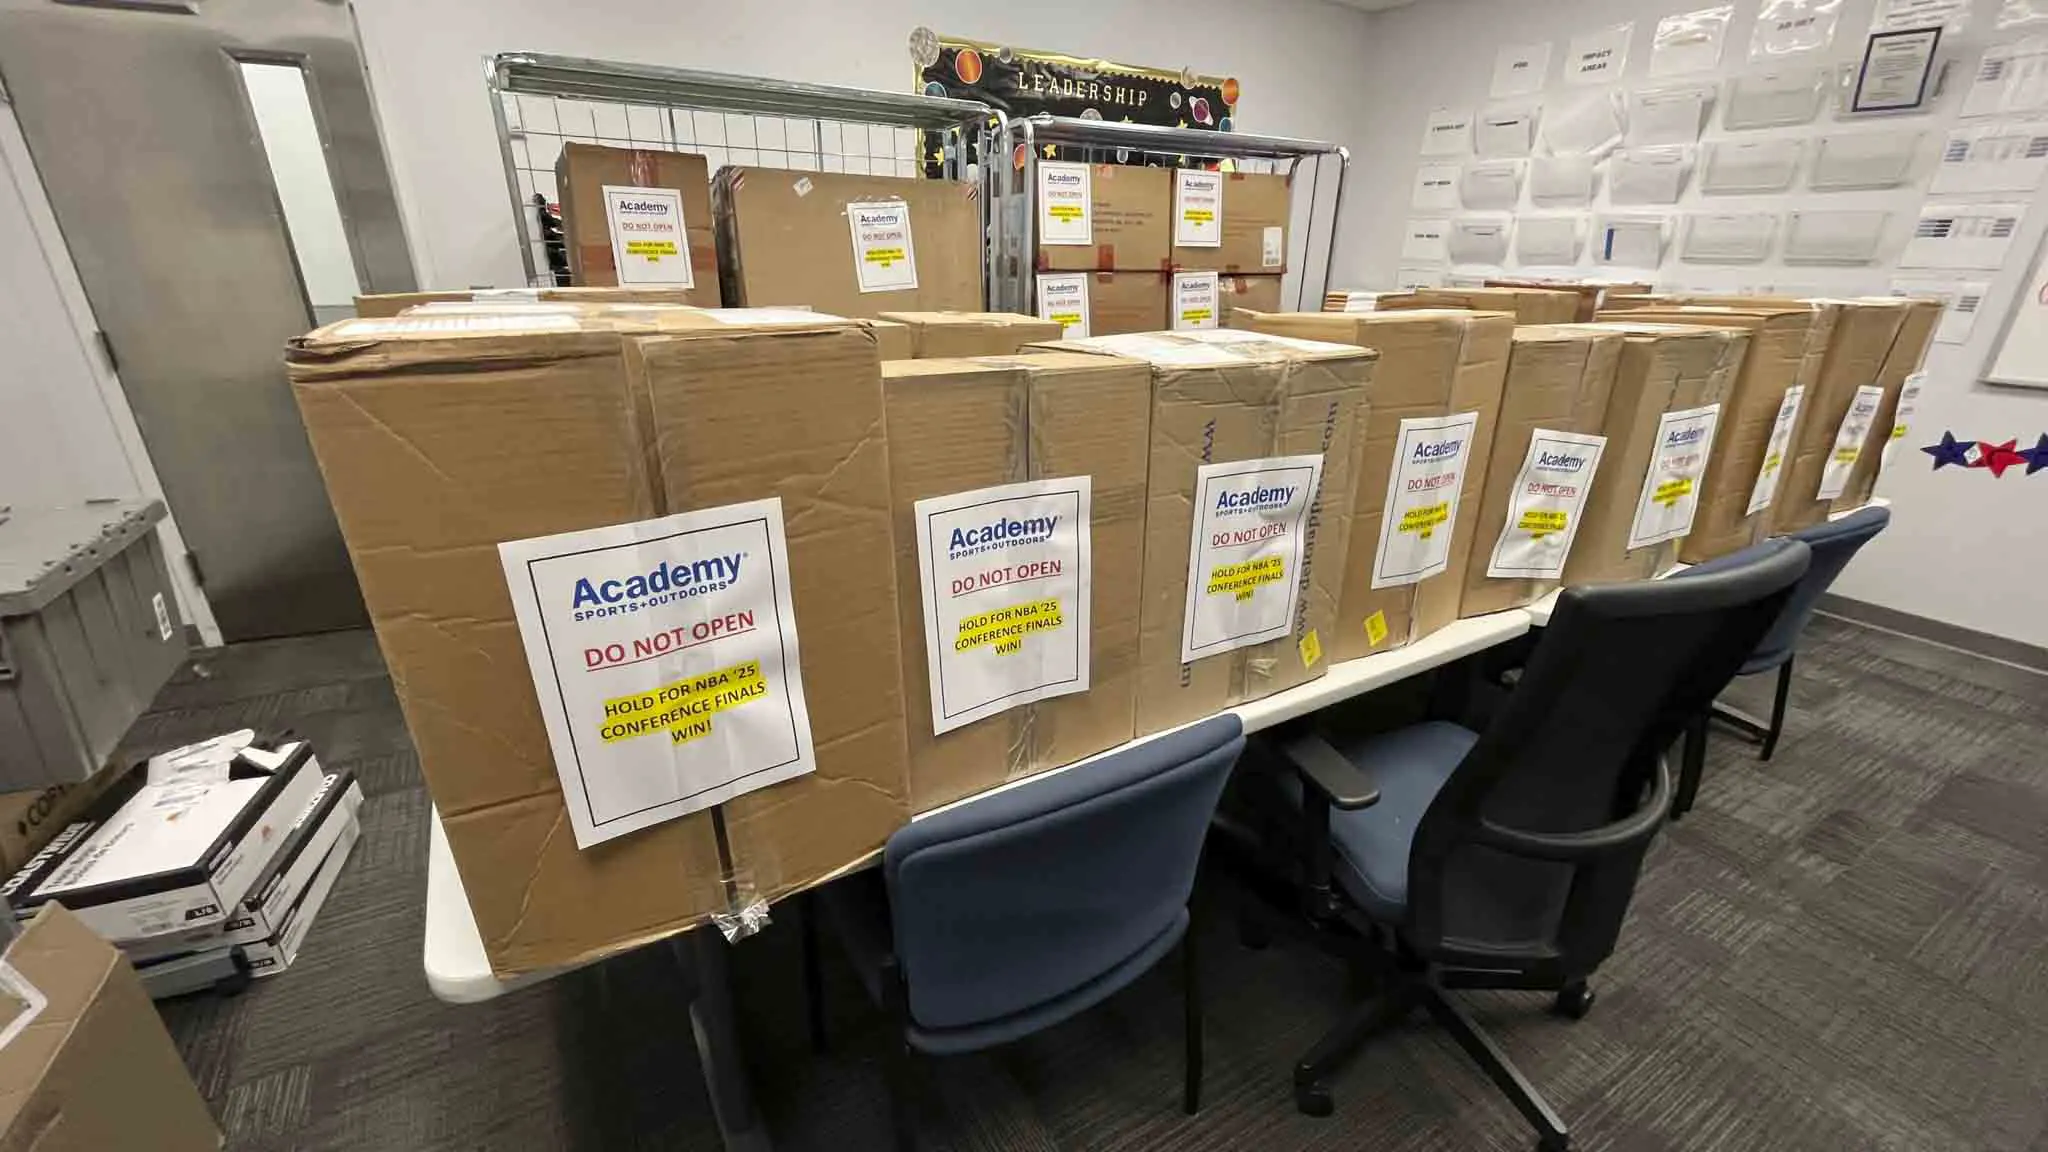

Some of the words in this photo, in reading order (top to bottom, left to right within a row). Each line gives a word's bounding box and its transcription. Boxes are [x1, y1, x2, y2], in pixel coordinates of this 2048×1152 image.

[1018, 72, 1147, 106] LEADERSHIP
[1048, 173, 1080, 184] Academy
[620, 200, 668, 213] Academy
[622, 222, 633, 230] DO
[636, 222, 650, 230] NOT
[860, 214, 898, 224] Academy
[1413, 439, 1463, 459] Academy
[1538, 452, 1584, 471] Academy
[1408, 479, 1422, 490] DO
[1424, 476, 1441, 488] NOT
[1216, 486, 1295, 510] Academy
[950, 516, 1057, 550] Academy
[1212, 533, 1230, 546] DO
[1233, 528, 1258, 543] NOT
[1260, 522, 1288, 538] OPEN
[573, 553, 740, 609] Academy
[952, 576, 974, 594] DO
[980, 567, 1012, 587] NOT
[1017, 560, 1062, 579] OPEN
[1212, 568, 1234, 579] HOLD
[1237, 564, 1250, 576] FOR
[1206, 577, 1256, 594] CONFERENCE
[575, 581, 727, 621] SPORTS+OUTDOORS
[959, 616, 988, 632] HOLD
[991, 612, 1011, 623] FOR
[1015, 605, 1037, 617] NBA
[584, 643, 625, 667] DO
[634, 627, 685, 657] NOT
[692, 609, 754, 640] OPEN
[955, 625, 1022, 650] CONFERENCE
[1026, 616, 1062, 631] FINALS
[995, 640, 1021, 655] WIN!
[604, 696, 654, 718] HOLD
[660, 684, 690, 704] FOR
[696, 673, 729, 692] NBA
[601, 699, 710, 740] CONFERENCE
[716, 681, 765, 708] FINALS
[671, 720, 713, 742] WIN!
